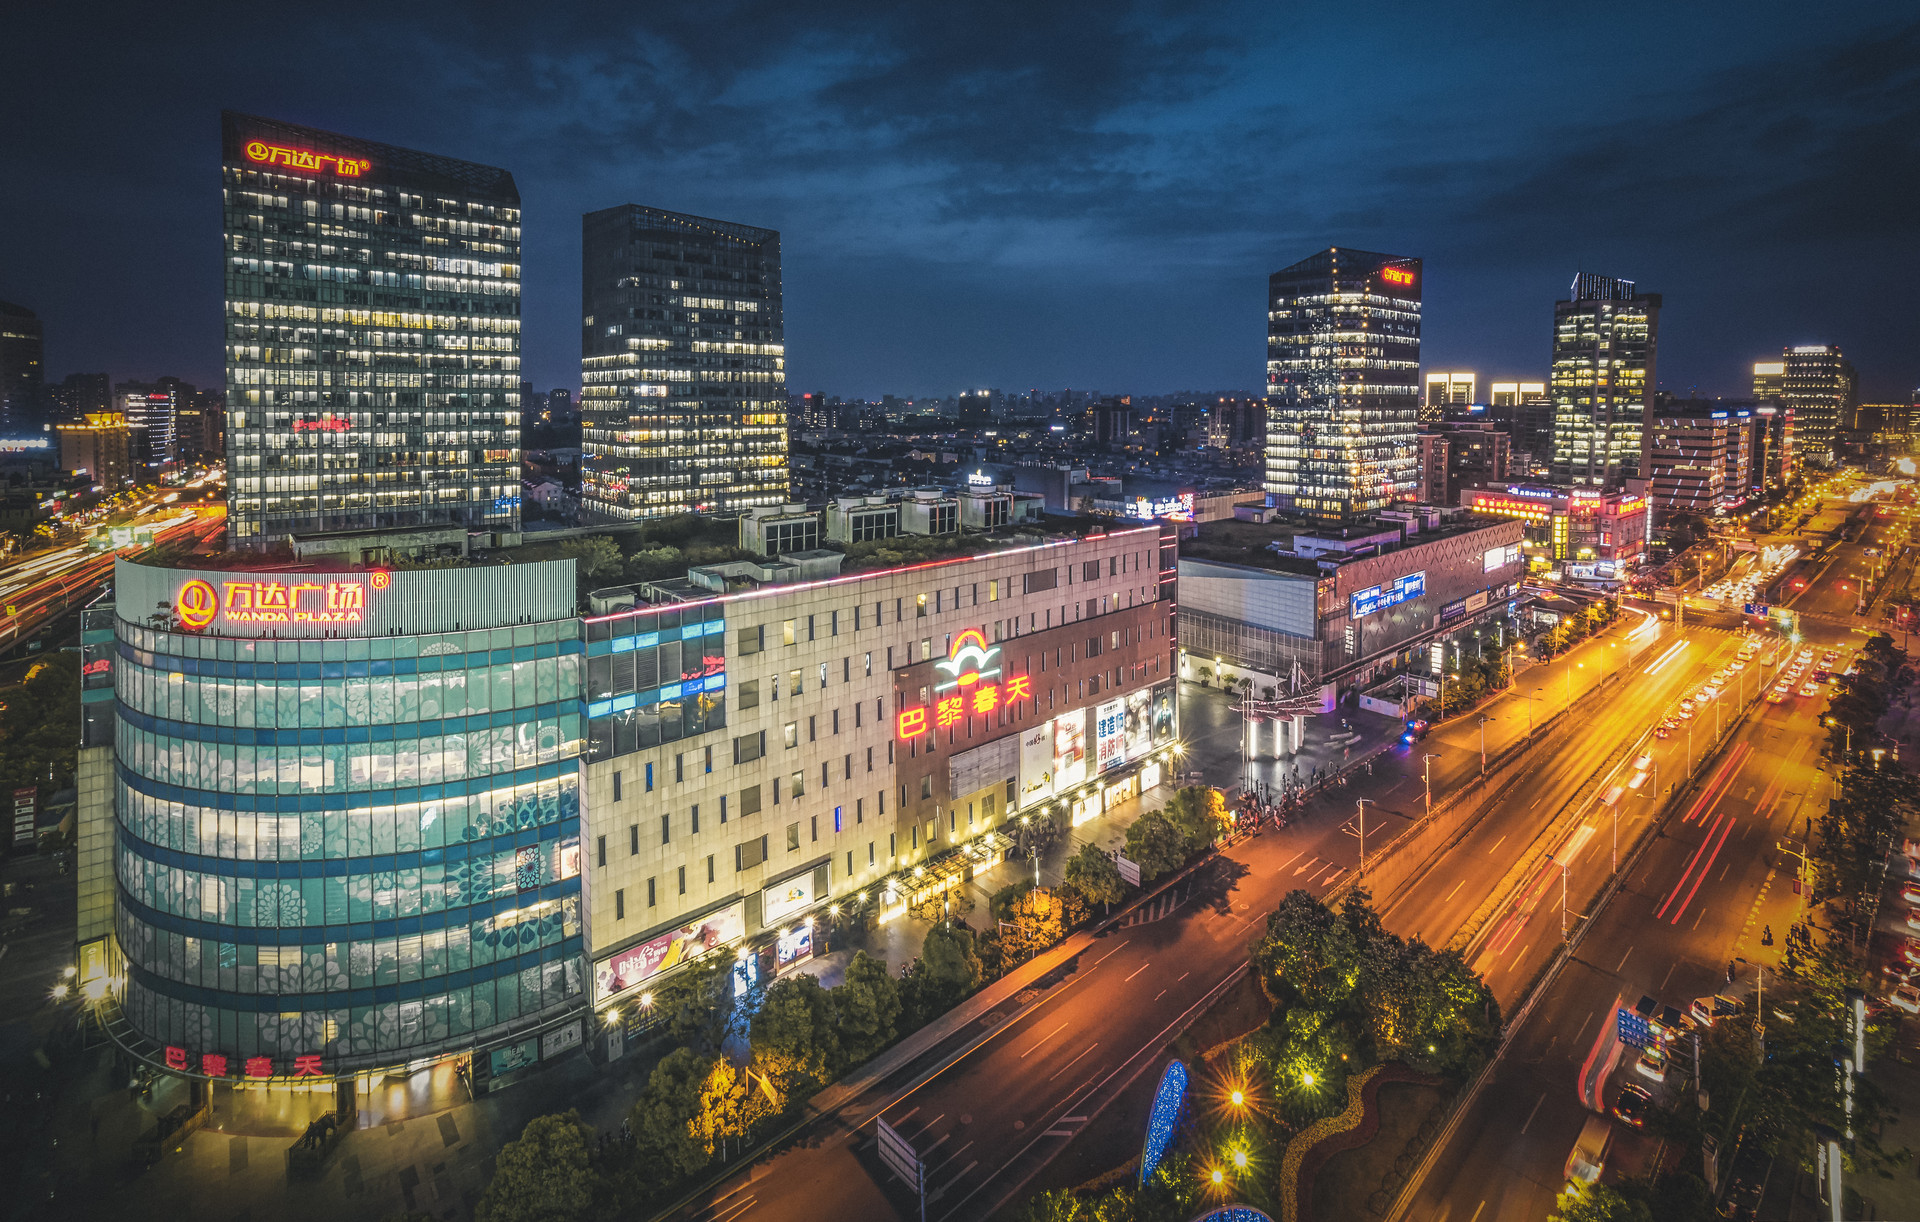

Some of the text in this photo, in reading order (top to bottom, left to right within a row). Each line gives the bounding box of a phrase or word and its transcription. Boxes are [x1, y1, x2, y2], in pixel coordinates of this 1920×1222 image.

[268, 145, 359, 176] 万达广场
[224, 582, 364, 609] 万达广场
[225, 611, 362, 622] WANDA PLAZA
[899, 674, 1031, 740] 巴黎春天
[165, 1046, 324, 1078] 巴黎春天
